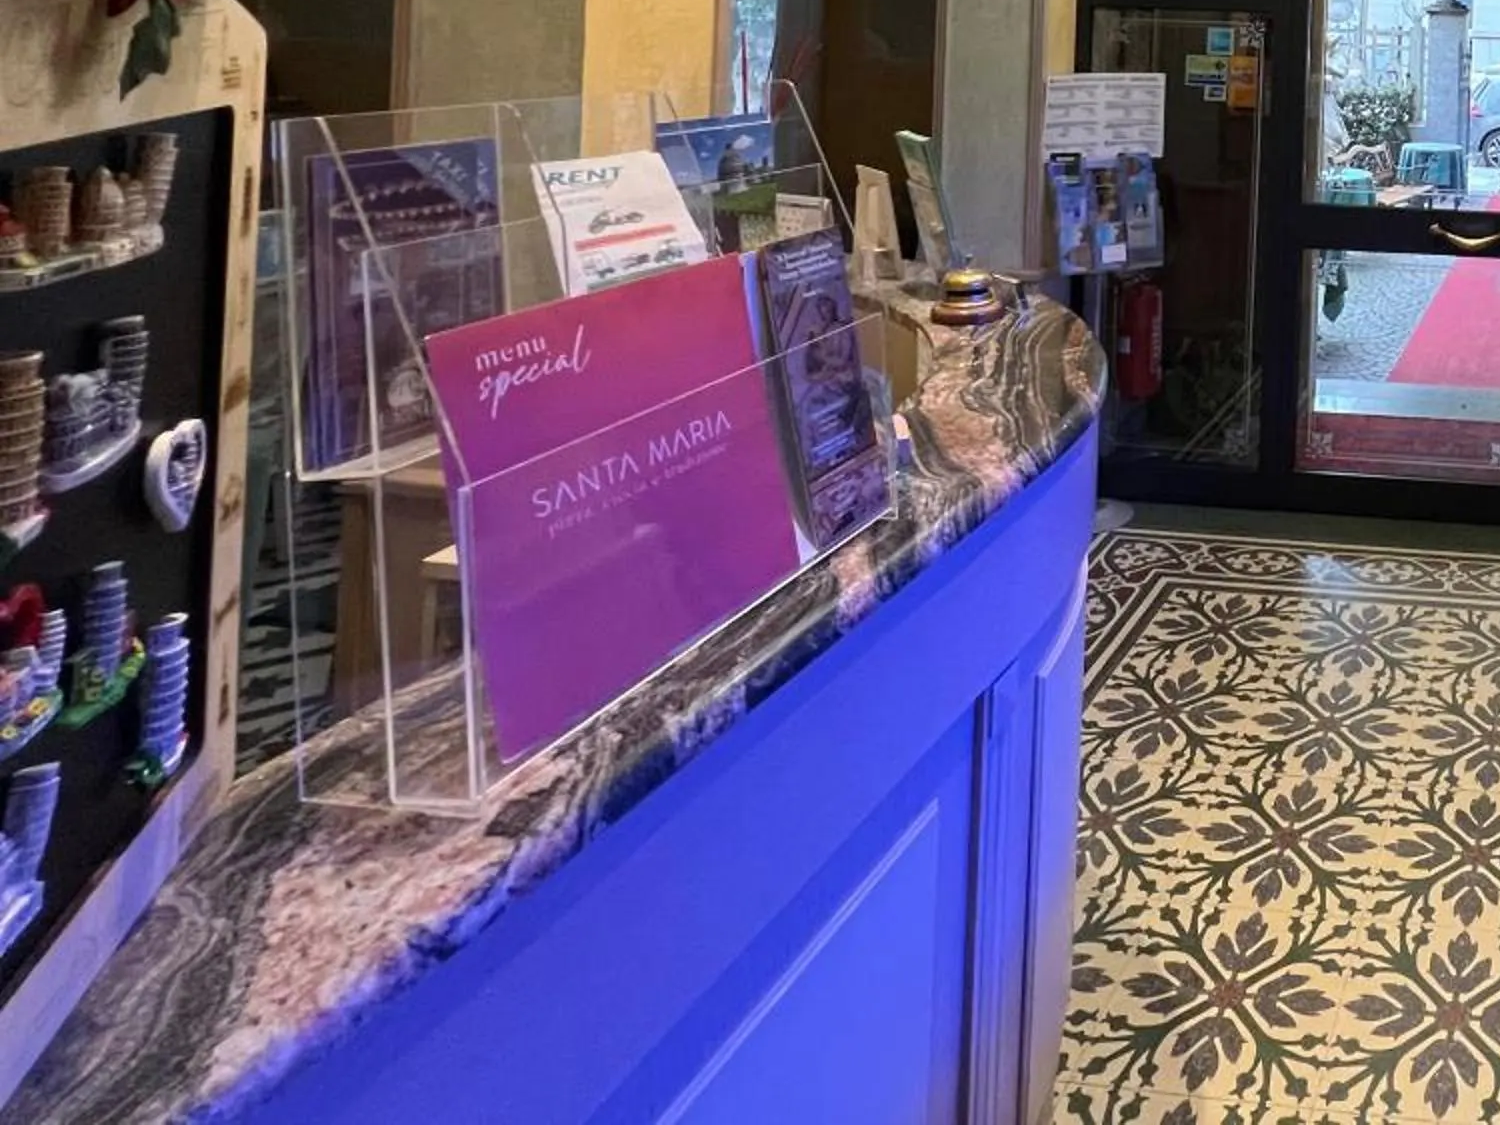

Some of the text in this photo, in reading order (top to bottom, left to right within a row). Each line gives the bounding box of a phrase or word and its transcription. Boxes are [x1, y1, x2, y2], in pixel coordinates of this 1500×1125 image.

[546, 166, 624, 185] RENT
[475, 336, 546, 372] menu
[479, 324, 592, 419] special
[532, 452, 640, 518] SANTA
[649, 410, 732, 466] MARIA
